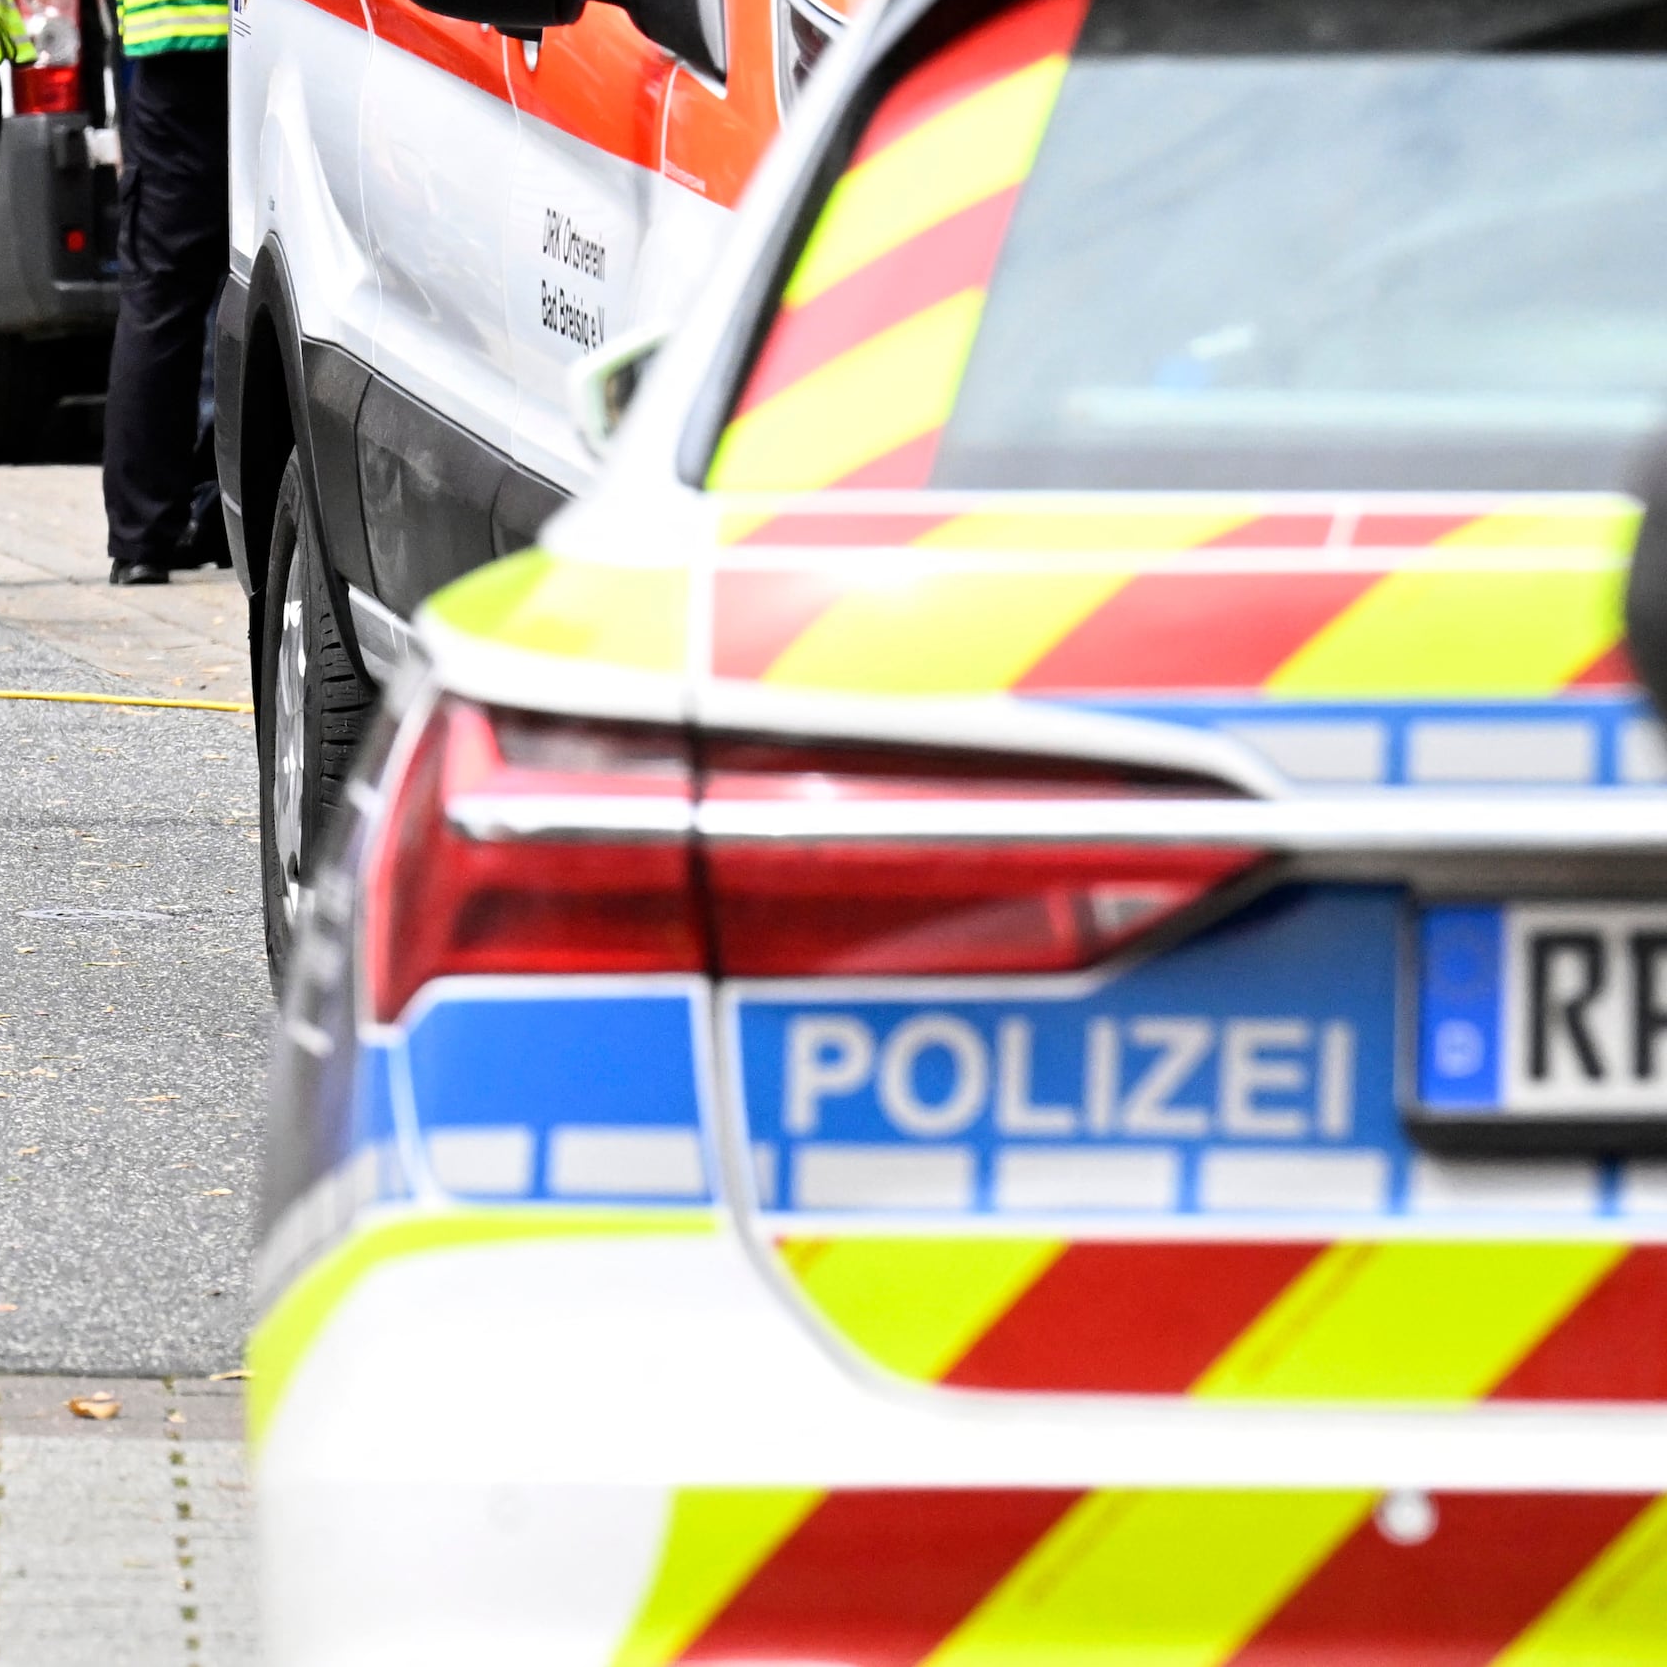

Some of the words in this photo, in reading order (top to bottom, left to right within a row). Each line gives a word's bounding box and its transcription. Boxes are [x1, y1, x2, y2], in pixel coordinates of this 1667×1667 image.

[543, 207, 563, 261] DRK
[563, 217, 605, 282] Ortsverein
[541, 279, 557, 332] Bad
[559, 287, 589, 356] Breisig
[783, 1013, 1358, 1137] POLIZEI
